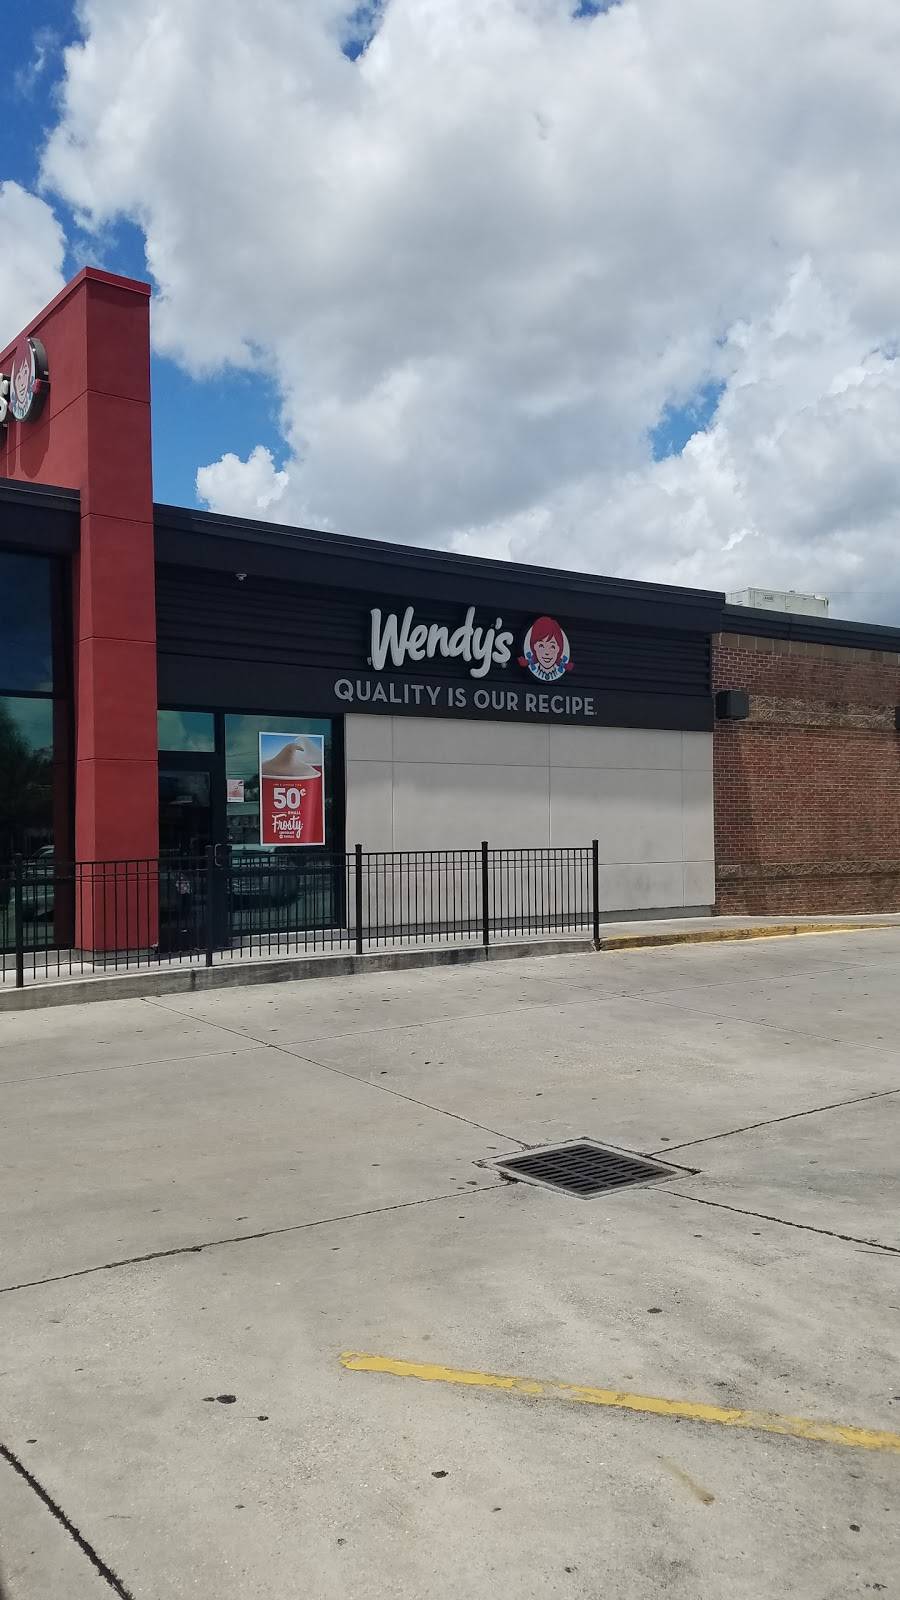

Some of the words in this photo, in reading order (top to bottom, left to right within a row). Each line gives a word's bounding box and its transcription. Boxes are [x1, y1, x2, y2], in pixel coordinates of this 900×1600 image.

[371, 606, 514, 678] Wendy's
[334, 679, 441, 706] QUALITY
[448, 687, 467, 708] IS
[473, 689, 519, 711] OUR
[271, 813, 304, 839] Frosty
